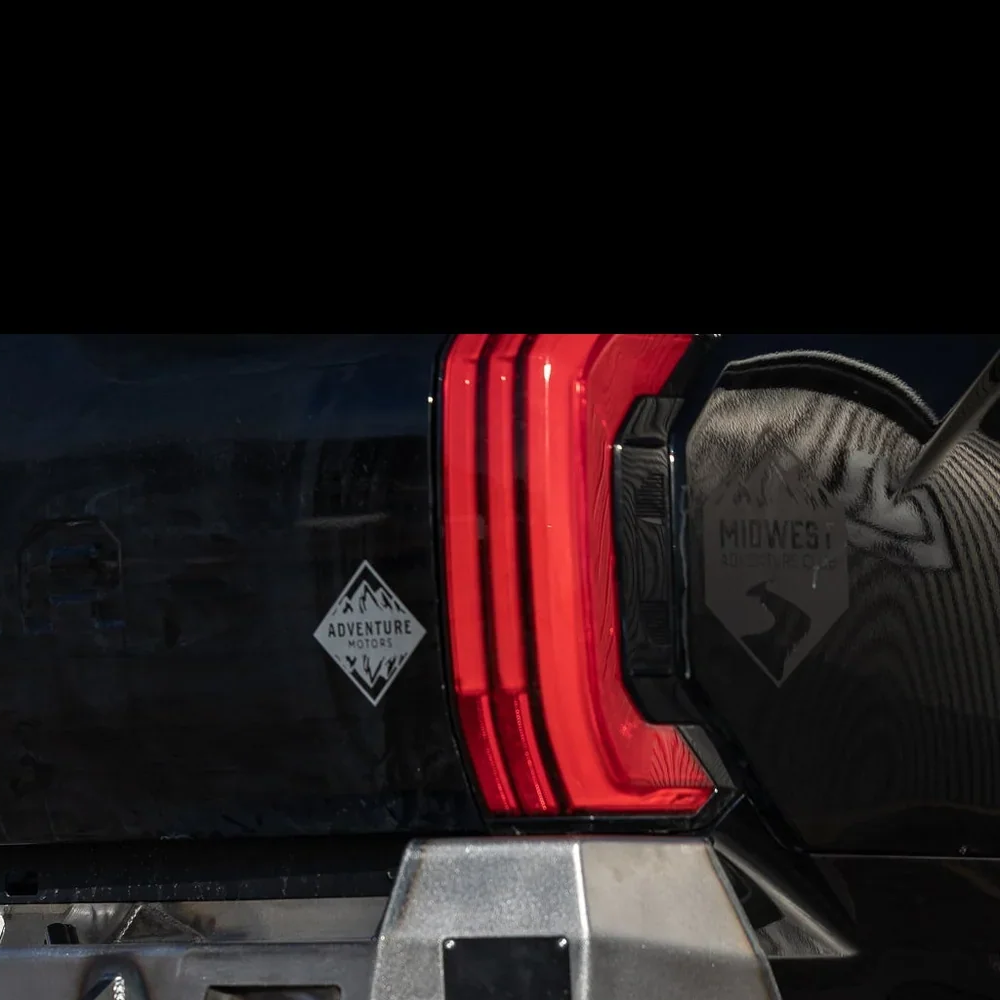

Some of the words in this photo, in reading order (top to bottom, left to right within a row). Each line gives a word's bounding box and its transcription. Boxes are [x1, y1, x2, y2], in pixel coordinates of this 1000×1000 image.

[720, 519, 832, 549] MIDWEST
[328, 620, 412, 637] ADVENTURE
[348, 638, 392, 649] MOTORS
